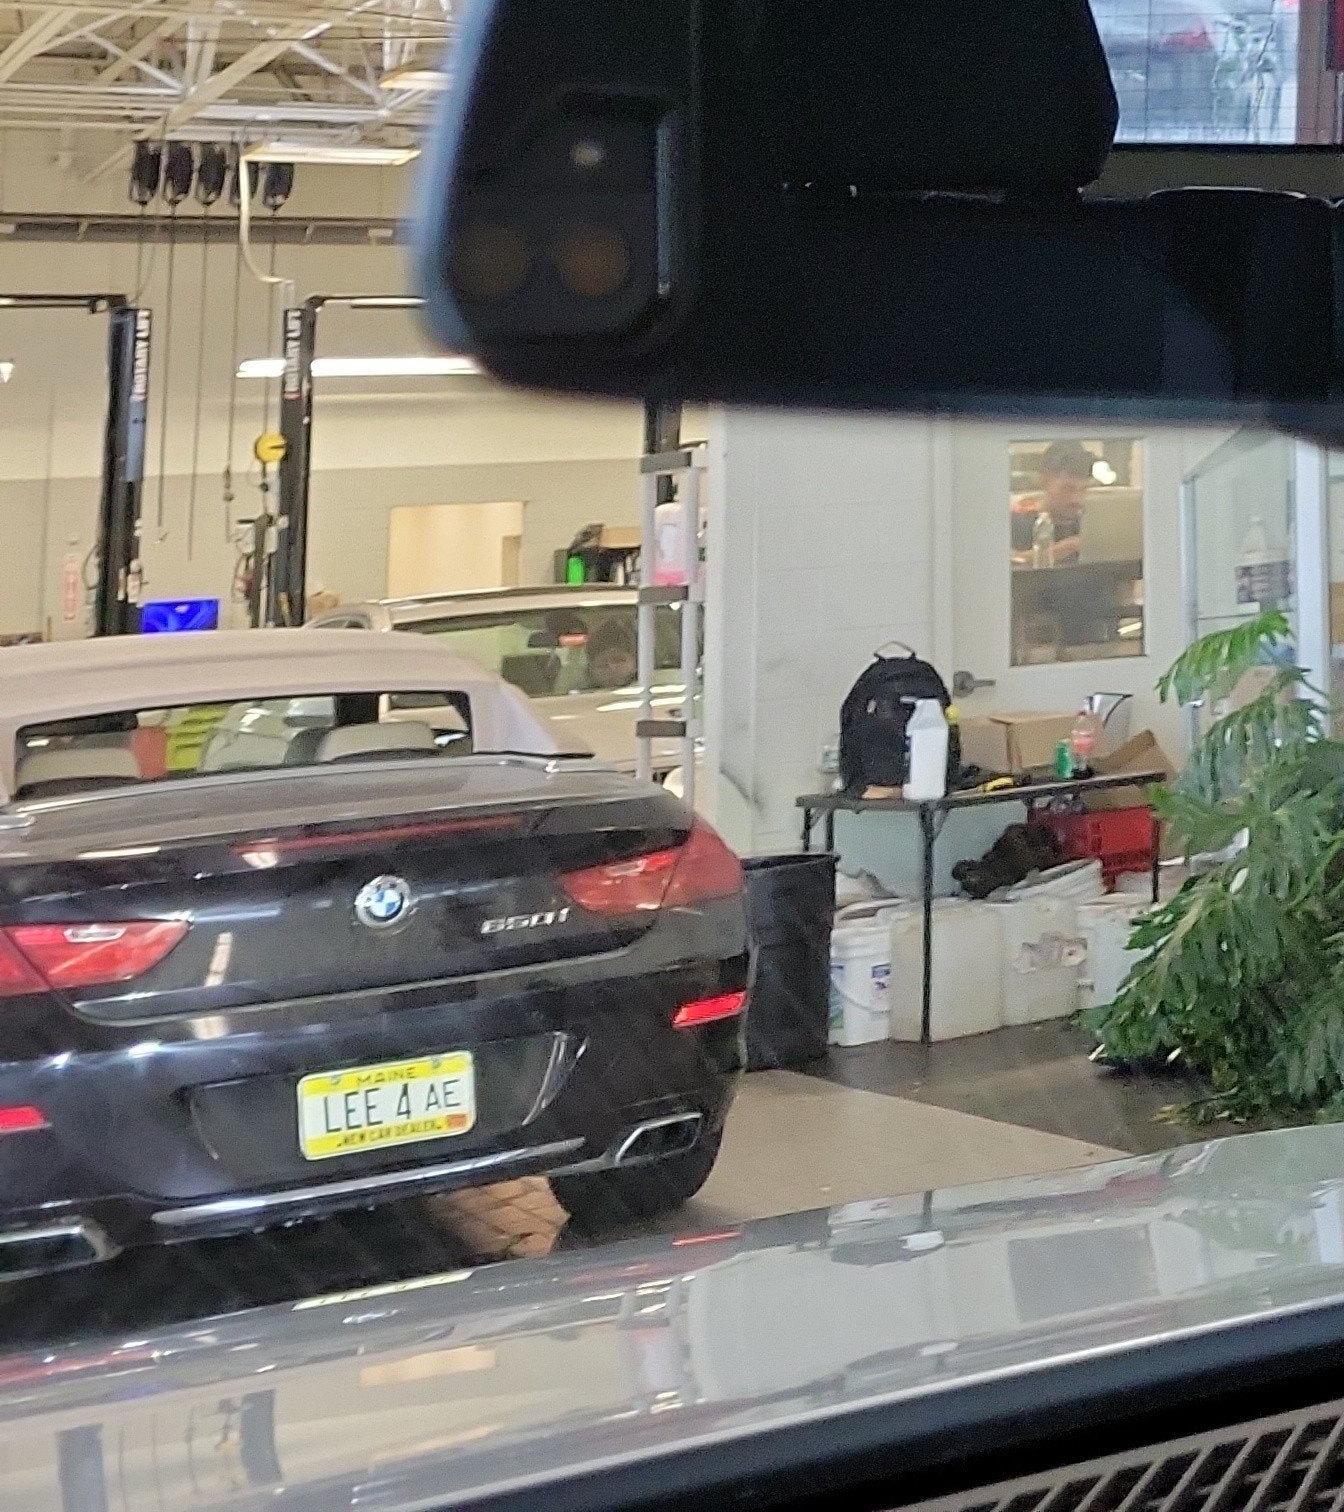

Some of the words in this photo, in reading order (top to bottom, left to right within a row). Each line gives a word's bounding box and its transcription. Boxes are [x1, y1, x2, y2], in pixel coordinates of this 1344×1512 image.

[356, 1066, 418, 1086] MAINE
[323, 1087, 384, 1133] LEE
[396, 1082, 412, 1120] 4
[425, 1078, 461, 1112] AE
[368, 1126, 391, 1141] CAR
[394, 1120, 436, 1137] DEALER
